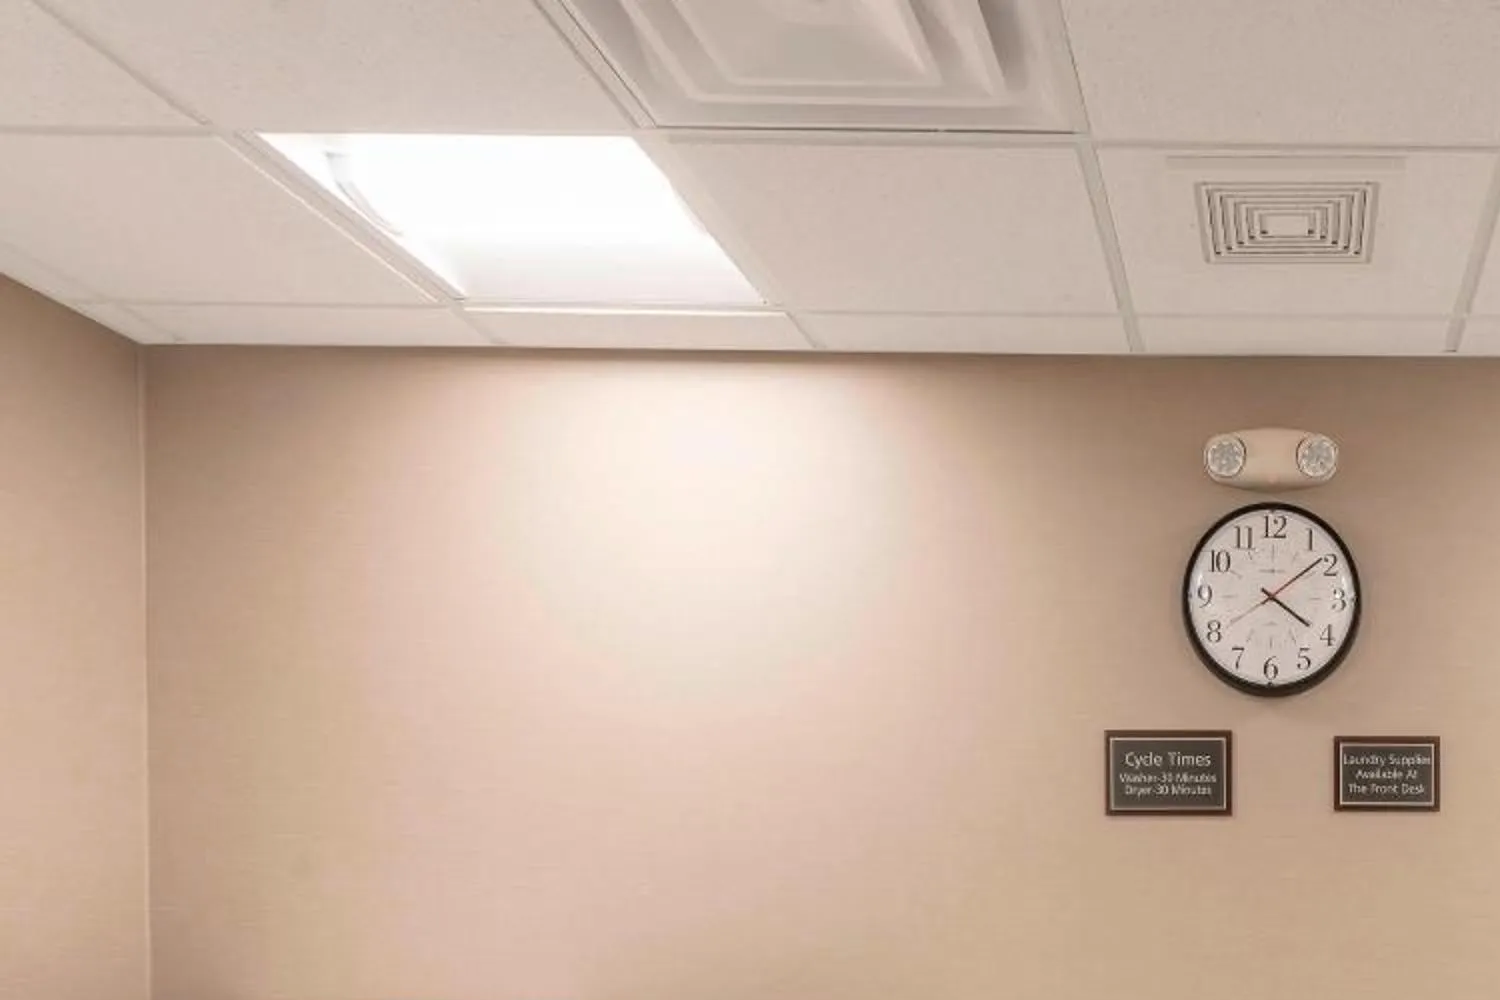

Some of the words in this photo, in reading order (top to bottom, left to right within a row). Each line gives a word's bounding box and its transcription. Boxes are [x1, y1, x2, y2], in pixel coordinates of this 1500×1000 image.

[1234, 525, 1256, 550] 11
[1264, 515, 1287, 539] 12
[1306, 528, 1314, 551] 1
[1209, 549, 1231, 573] 10
[1323, 553, 1338, 577] 2
[1197, 585, 1213, 608] 9
[1331, 588, 1347, 612] 3
[1207, 620, 1222, 643] 8
[1319, 624, 1335, 647] 4
[1231, 647, 1245, 669] 7
[1263, 656, 1279, 680] 6
[1297, 648, 1311, 670] 5
[1125, 751, 1163, 769] Cycle
[1167, 751, 1211, 767] Times
[1343, 753, 1385, 767] Laundry
[1355, 768, 1403, 780] Available
[1348, 783, 1368, 794] The
[1369, 783, 1399, 795] Front
[1401, 783, 1424, 795] Desk
